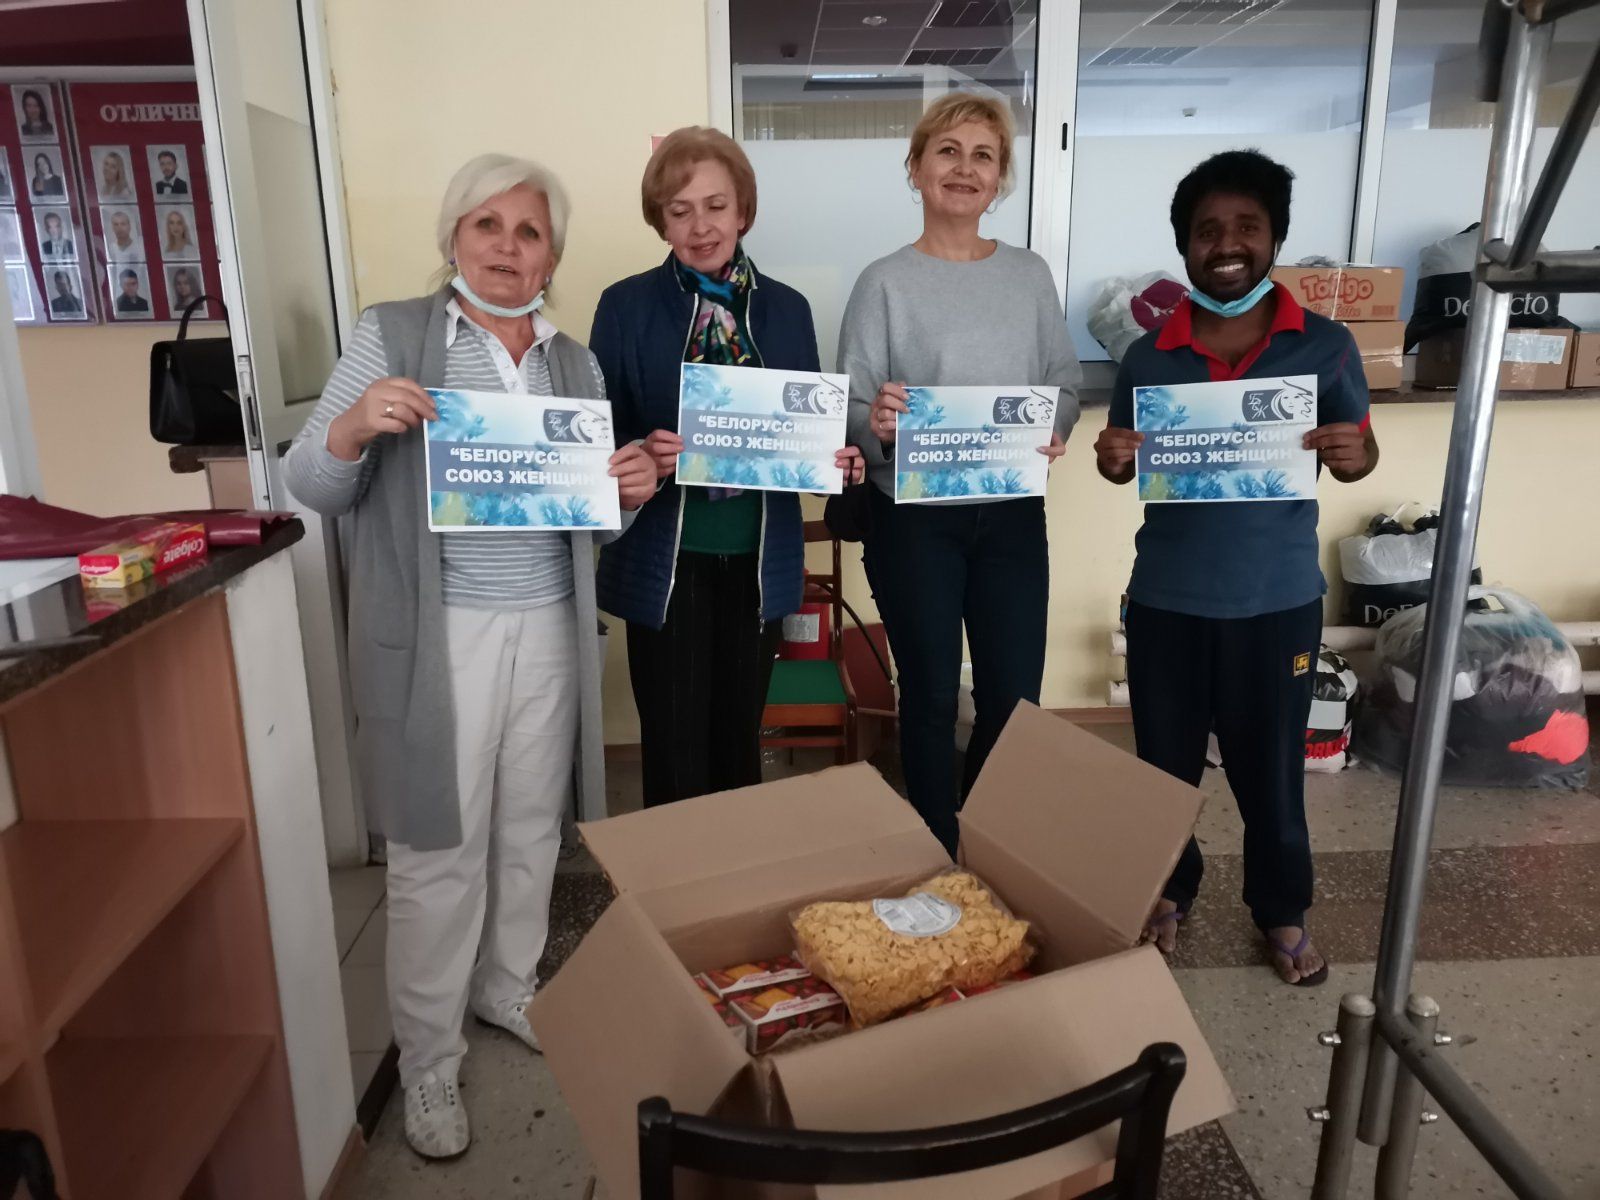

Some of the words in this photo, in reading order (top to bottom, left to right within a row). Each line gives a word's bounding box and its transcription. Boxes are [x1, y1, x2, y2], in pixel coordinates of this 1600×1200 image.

[100, 103, 202, 122] ОТЛИЧН
[1444, 292, 1549, 317] Decto
[698, 415, 827, 434] “БЕЛОРУССКИ
[692, 432, 743, 448] СОЮЗ
[450, 446, 600, 467] “БЕЛОРУССКИ
[908, 451, 954, 464] СОЮЗ
[1150, 452, 1202, 465] СОЮЗ
[1206, 449, 1292, 464] ЖЕНЩИН
[445, 468, 504, 484] СОЮЗ
[163, 538, 204, 564] Colgate
